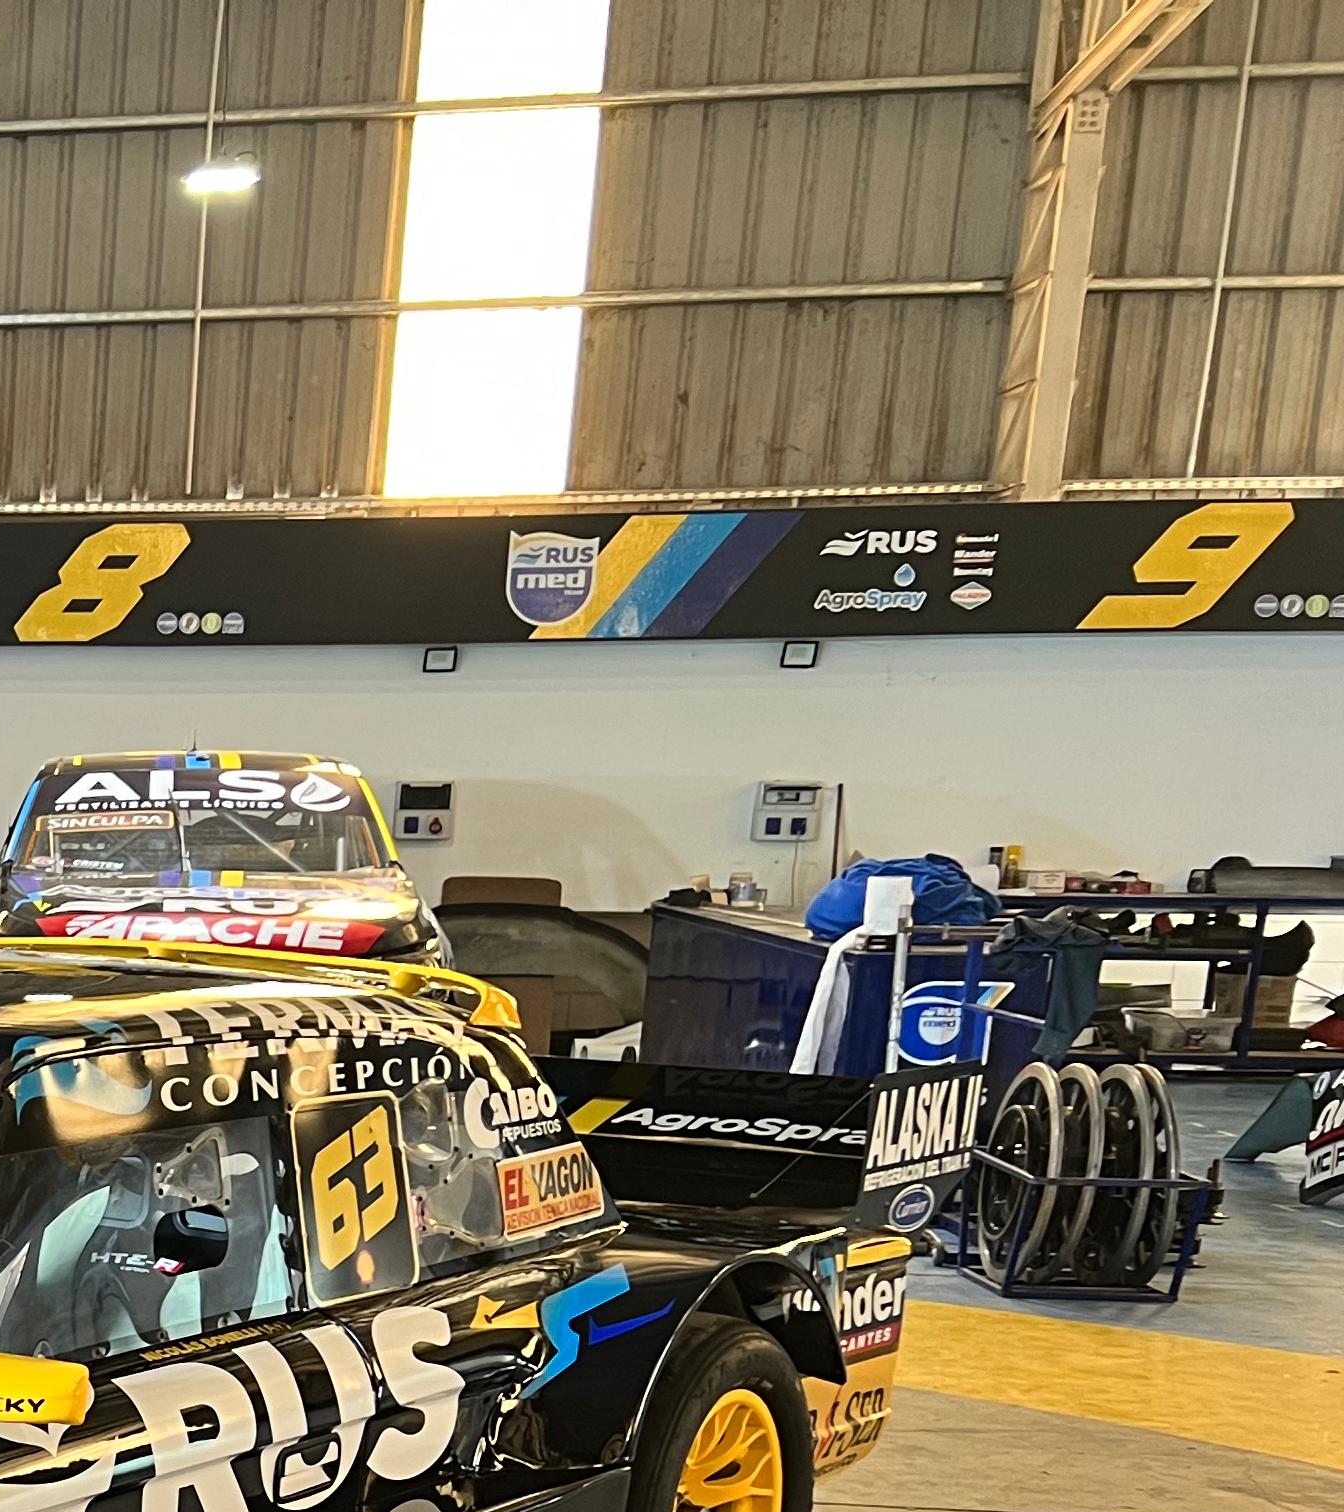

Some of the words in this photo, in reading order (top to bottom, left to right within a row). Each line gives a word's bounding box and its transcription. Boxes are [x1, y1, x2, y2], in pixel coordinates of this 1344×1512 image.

[546, 547, 593, 564] RUS
[866, 530, 938, 553] RUS
[14, 523, 190, 641] 8
[516, 569, 586, 589] med
[1076, 502, 1295, 629] 9
[814, 589, 927, 612] AgroSpray
[55, 769, 286, 805] ALS
[47, 814, 164, 830] SINCULPA
[866, 1078, 960, 1170] ALASKA
[312, 1104, 400, 1268] 63
[504, 1166, 530, 1211] EL
